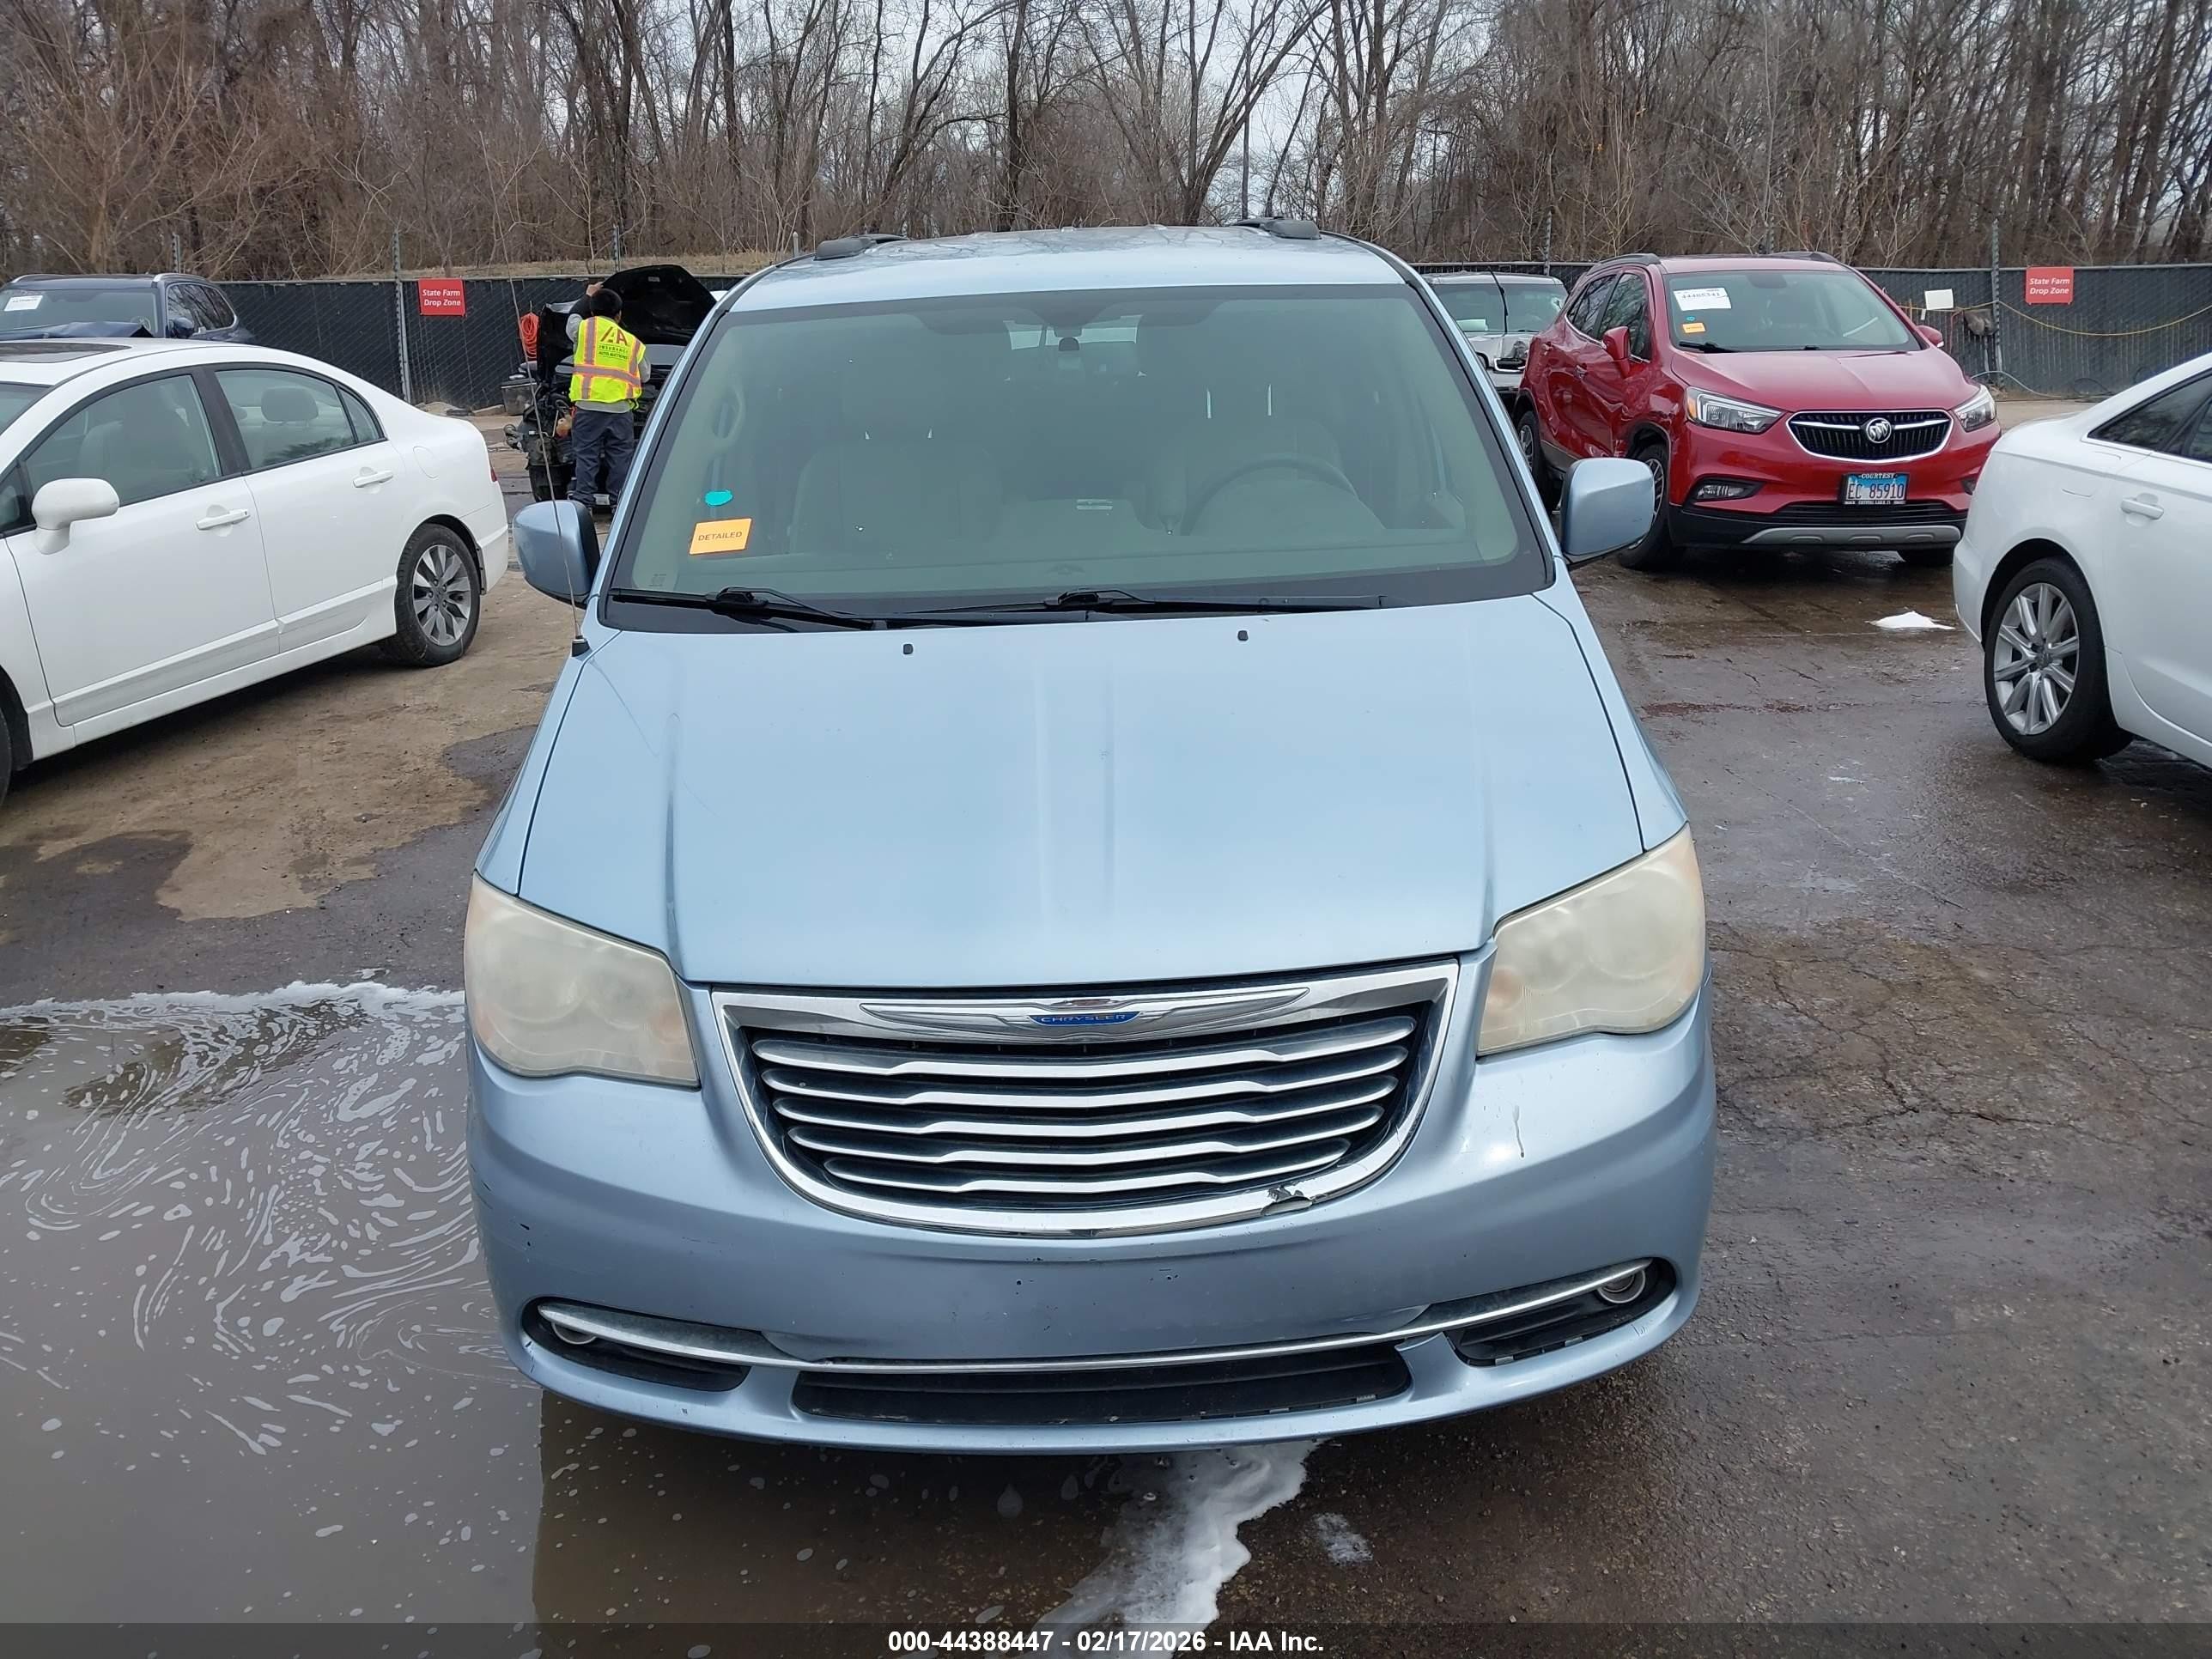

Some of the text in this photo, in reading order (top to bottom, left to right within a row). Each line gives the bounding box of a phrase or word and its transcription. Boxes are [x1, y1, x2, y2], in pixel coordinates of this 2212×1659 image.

[1848, 483, 1905, 499] EC 85910
[698, 532, 742, 541] DETAILED
